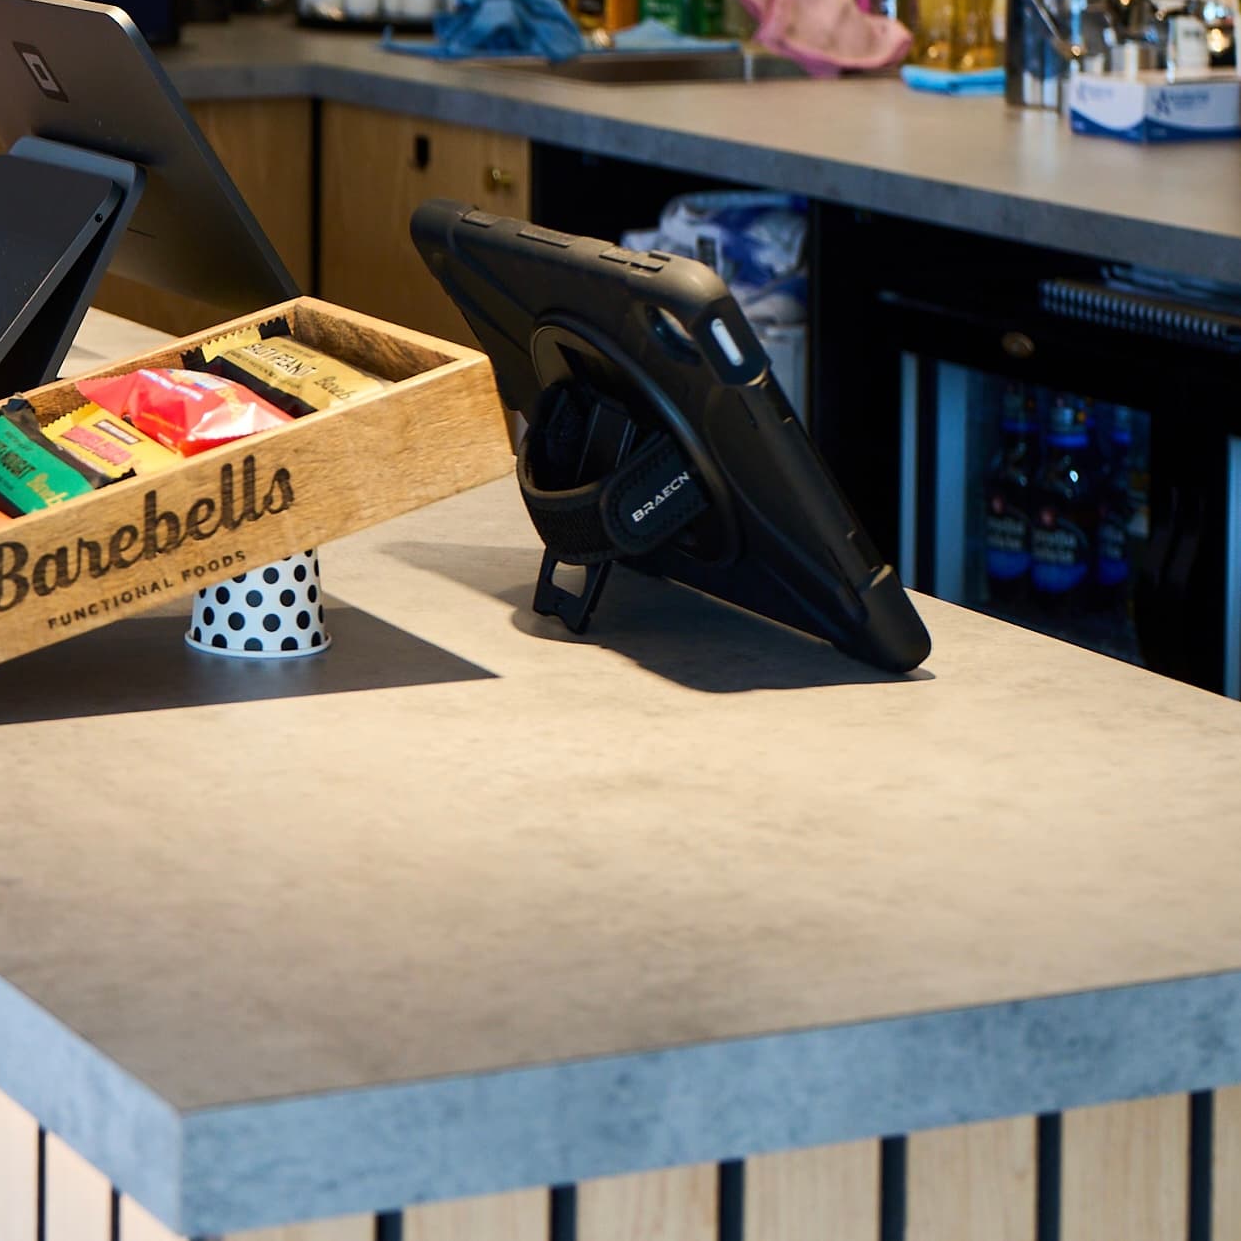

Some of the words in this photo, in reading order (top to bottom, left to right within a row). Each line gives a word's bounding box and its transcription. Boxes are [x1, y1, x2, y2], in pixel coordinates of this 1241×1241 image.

[631, 470, 690, 523] BRAECN
[47, 578, 174, 630] FUNCTIONAL
[181, 549, 247, 583] FOODS
